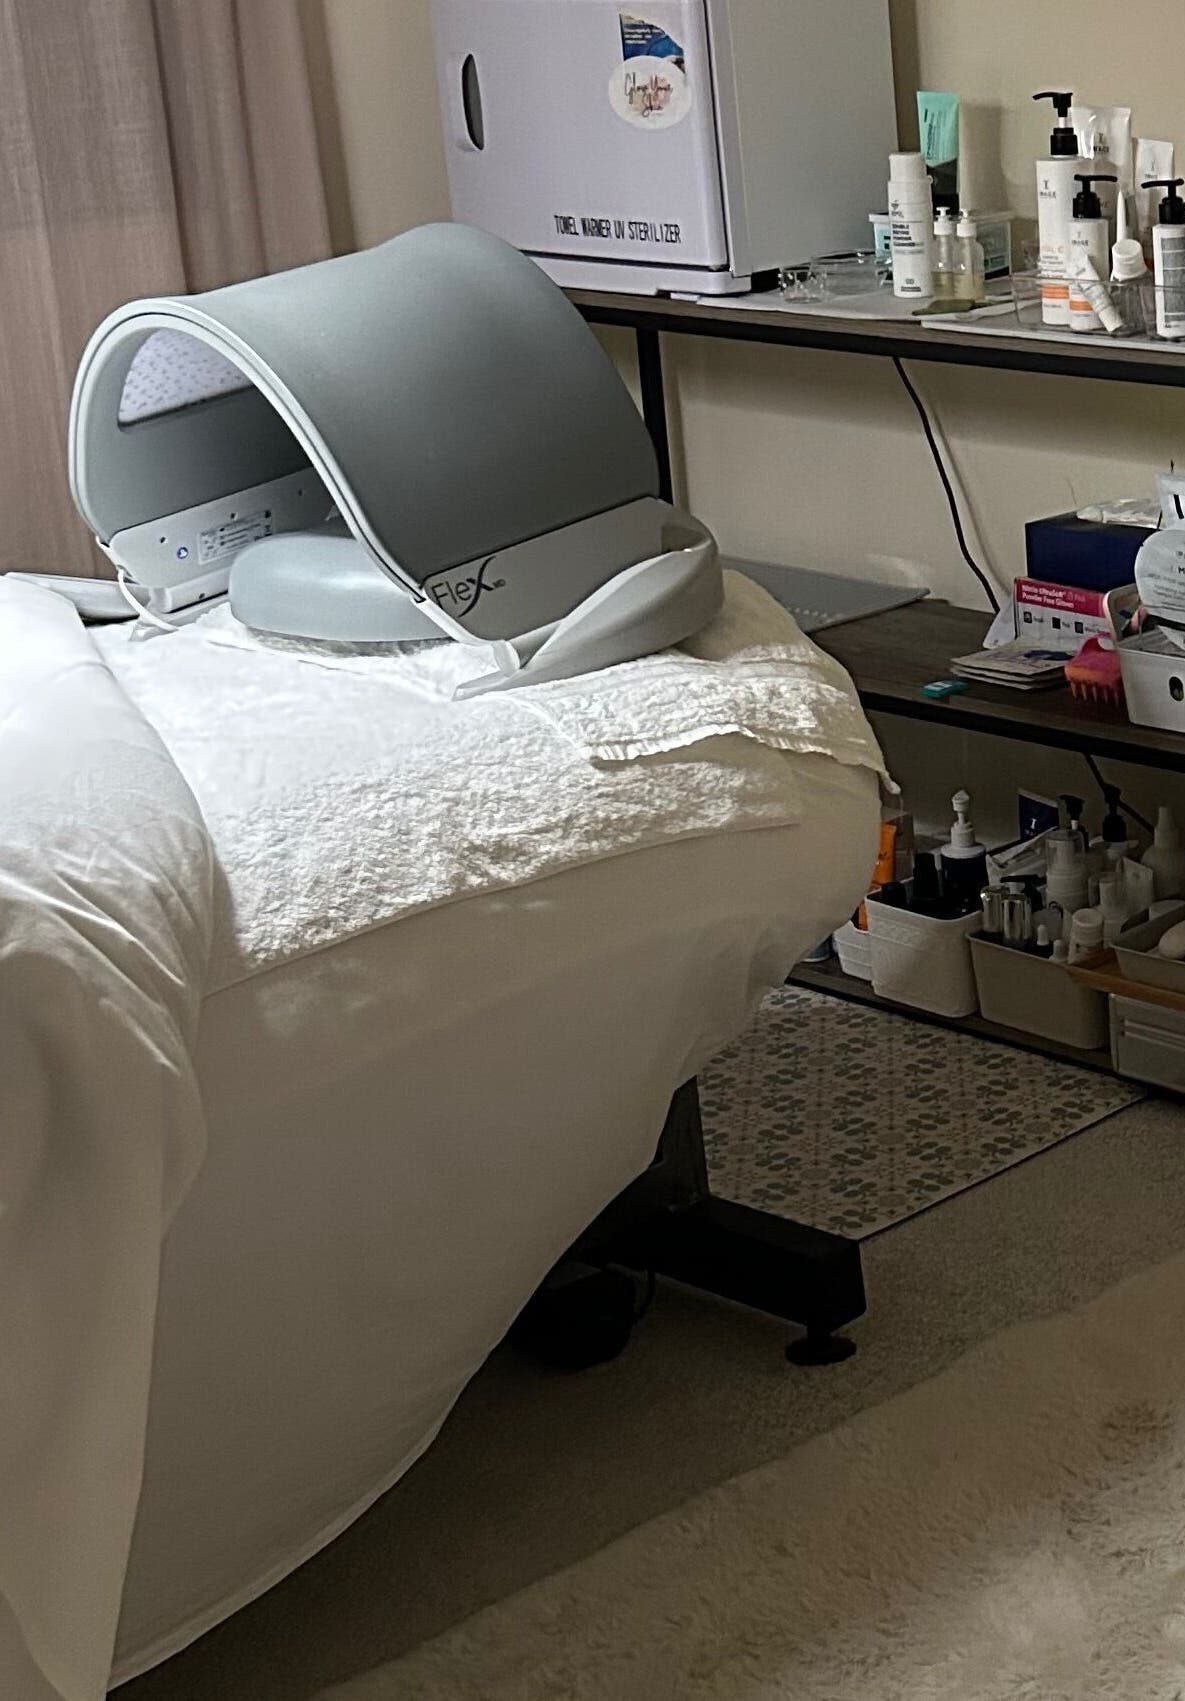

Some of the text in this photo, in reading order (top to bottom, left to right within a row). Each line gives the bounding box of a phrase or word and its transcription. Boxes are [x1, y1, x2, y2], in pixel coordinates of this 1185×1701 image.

[553, 214, 579, 236] TOWEL
[613, 219, 625, 240] UV
[628, 221, 682, 244] STERILIZER
